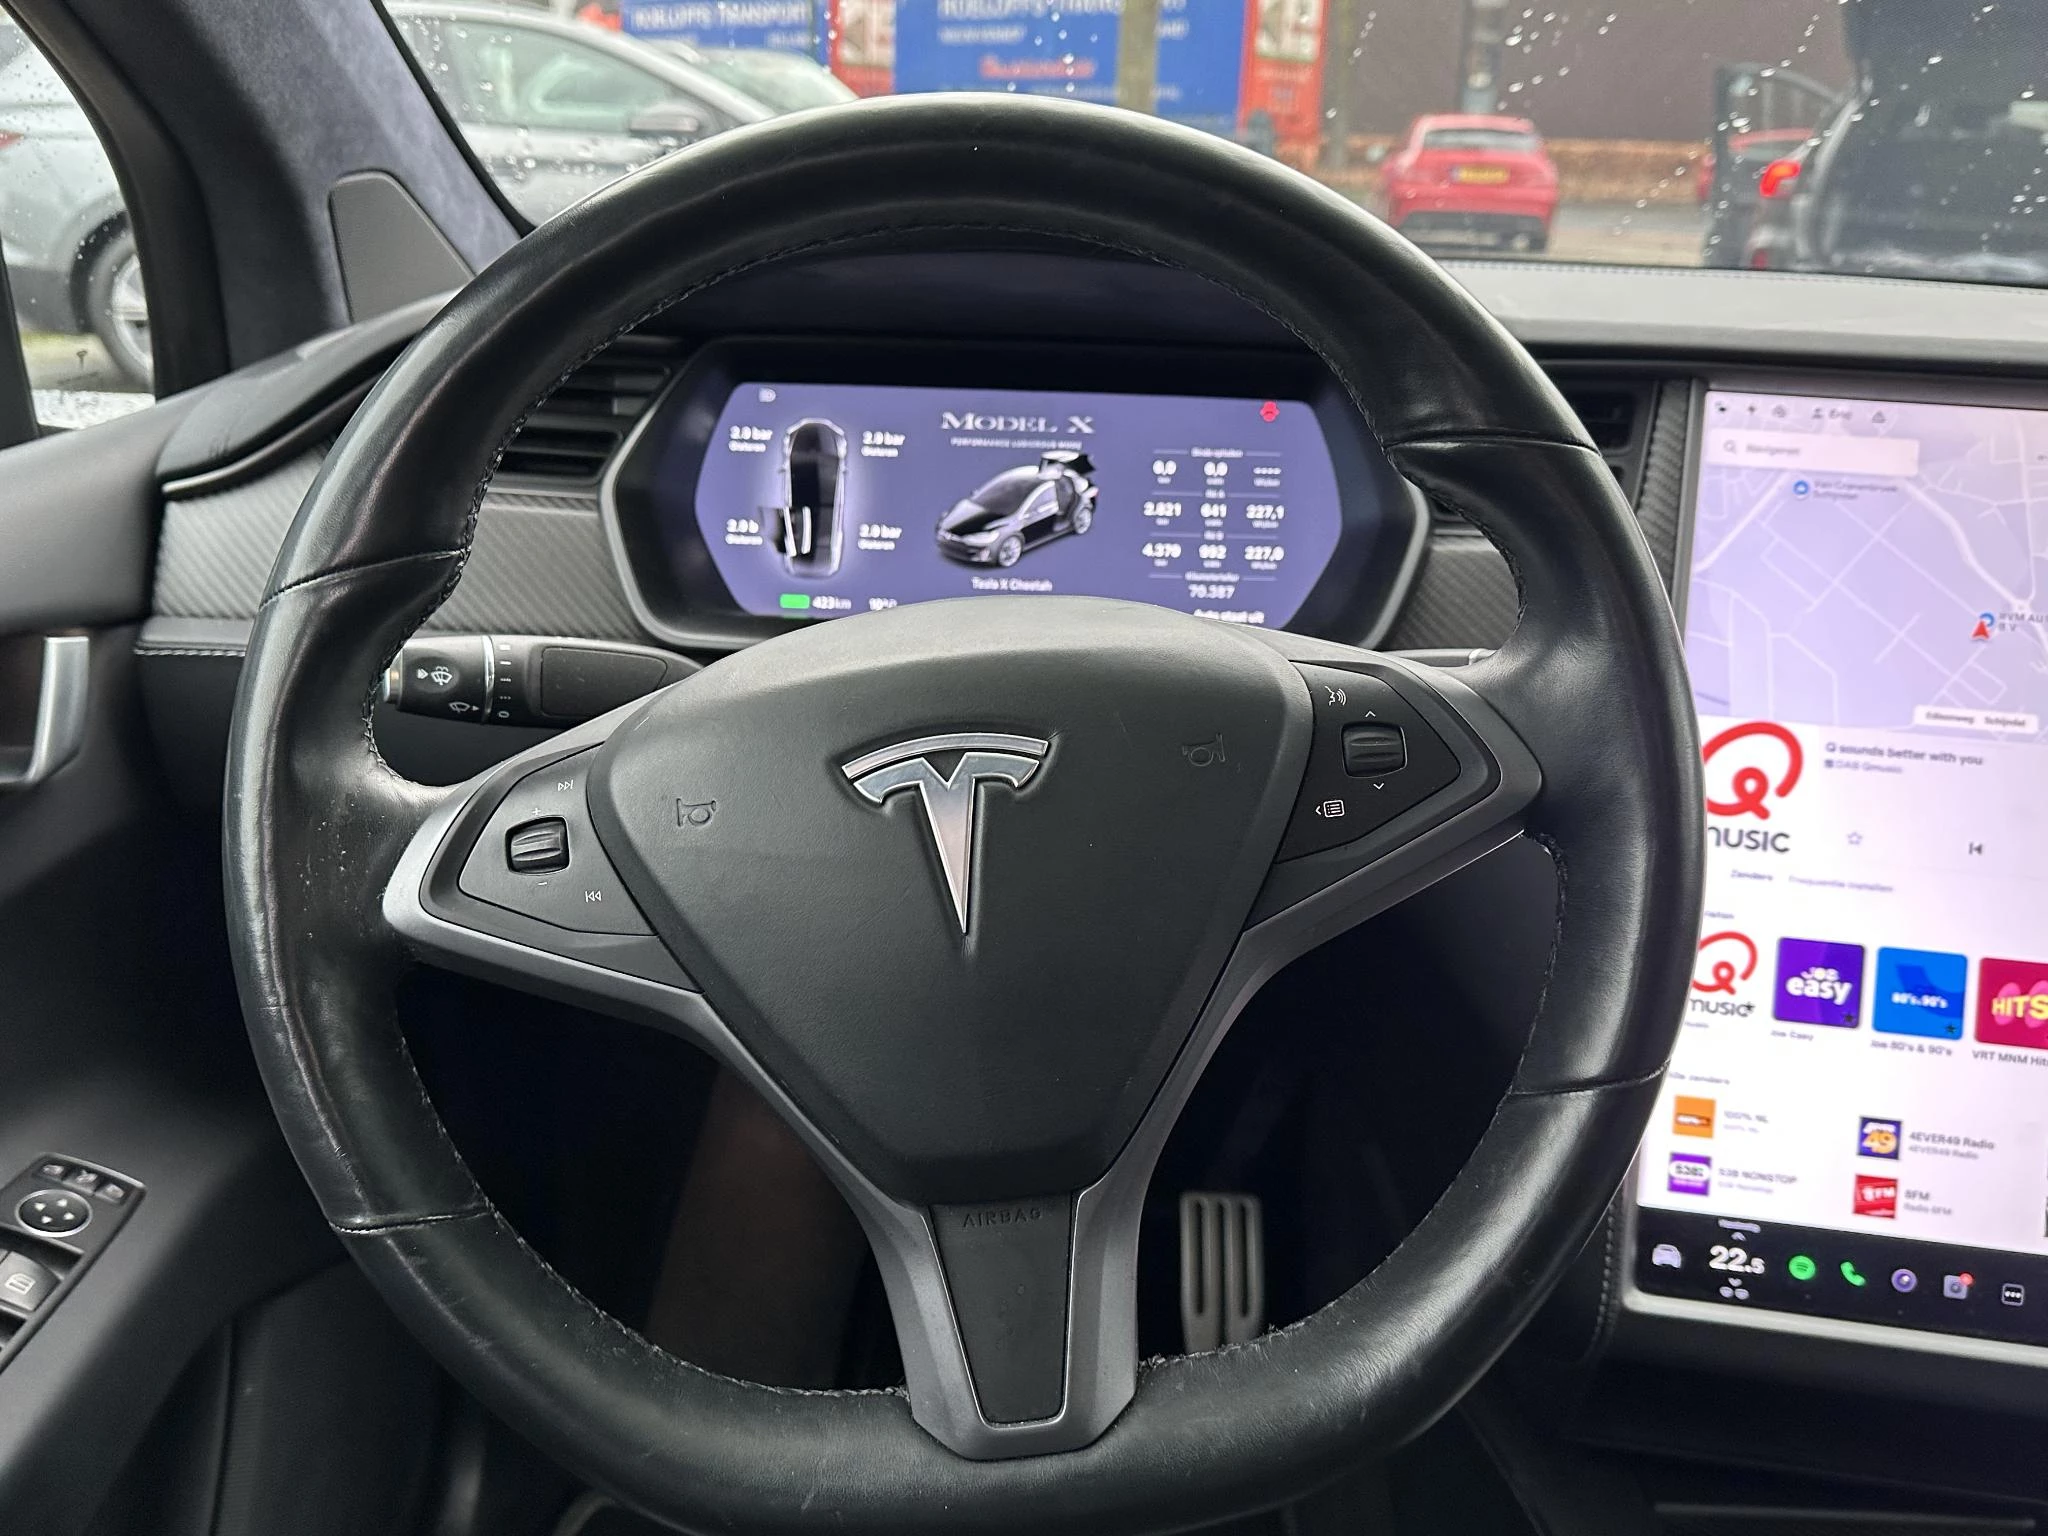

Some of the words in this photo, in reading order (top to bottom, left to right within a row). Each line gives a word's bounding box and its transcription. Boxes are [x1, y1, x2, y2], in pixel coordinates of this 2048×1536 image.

[941, 412, 1057, 432] MODEL
[1067, 416, 1095, 434] X
[1839, 743, 1885, 758] sounds
[1887, 746, 1927, 761] better
[1929, 749, 1957, 764] with
[1960, 754, 1984, 767] you
[1785, 975, 1853, 1006] easy
[1991, 994, 2048, 1021] HITS
[1972, 1049, 1996, 1061] VRT
[1998, 1053, 2028, 1065] MNM
[1963, 1136, 1995, 1150] Radio
[962, 1207, 1042, 1229] AIRBAG
[1708, 1244, 1766, 1275] 22.5
